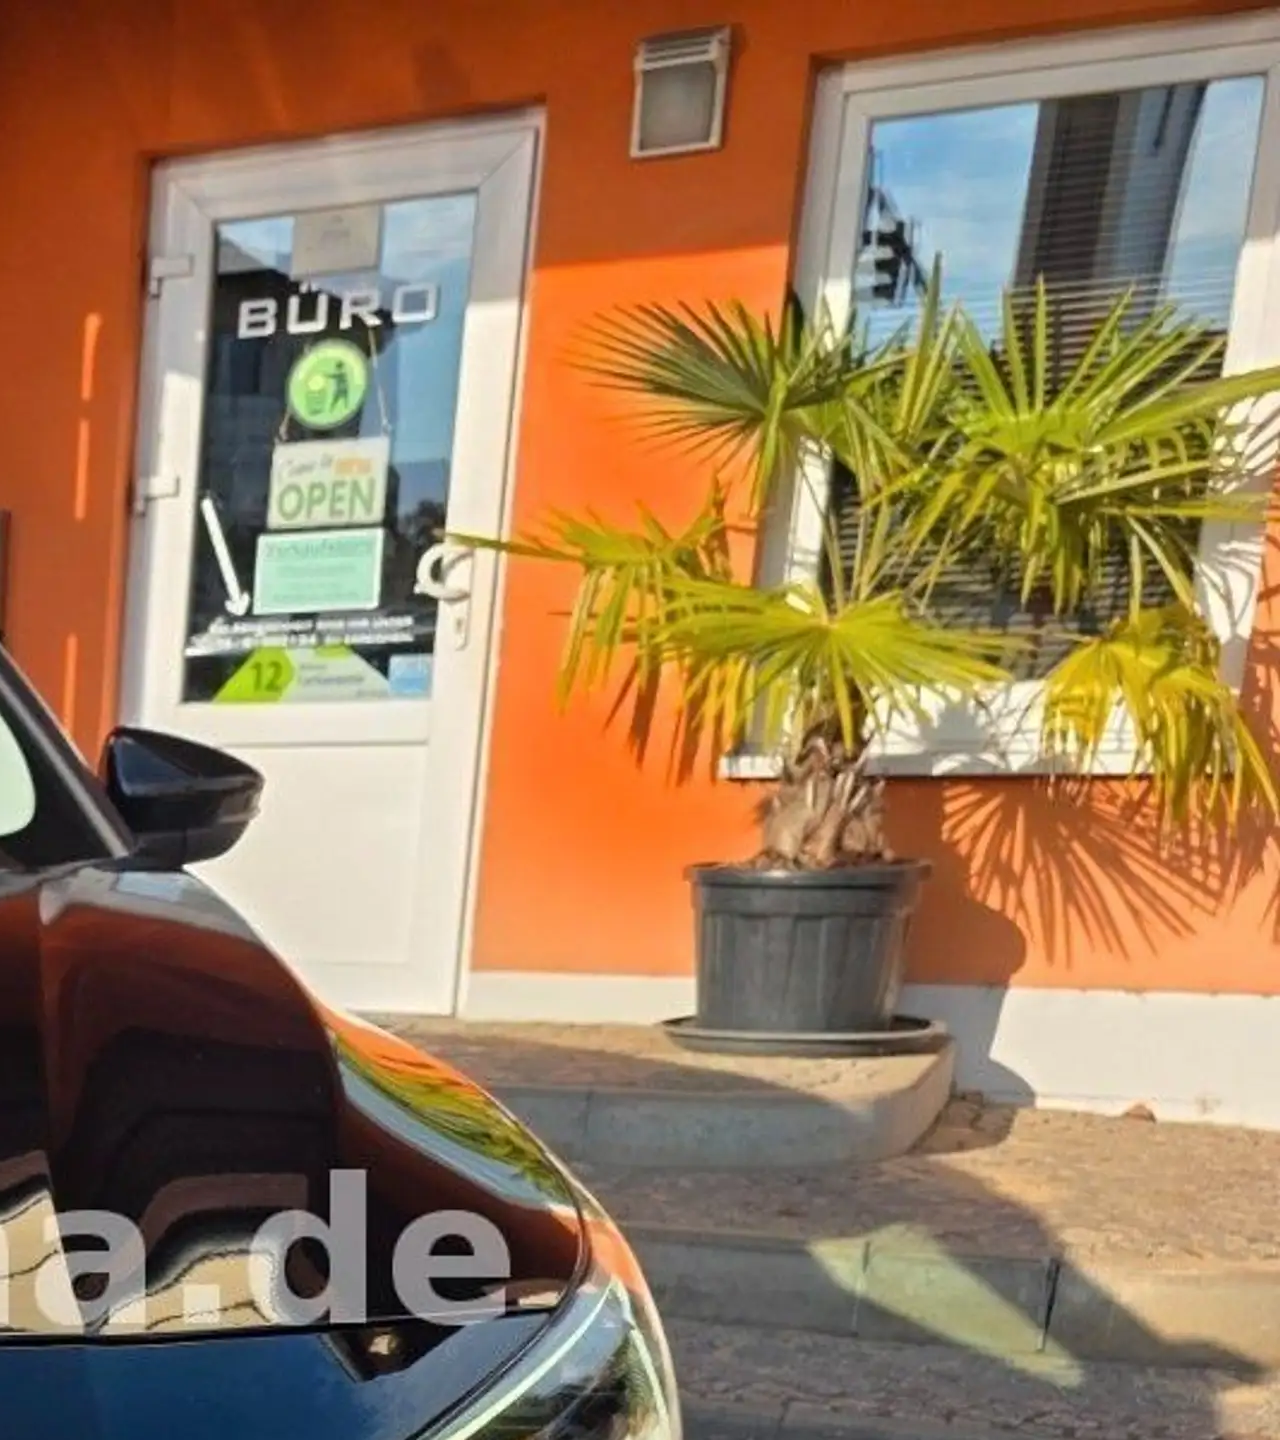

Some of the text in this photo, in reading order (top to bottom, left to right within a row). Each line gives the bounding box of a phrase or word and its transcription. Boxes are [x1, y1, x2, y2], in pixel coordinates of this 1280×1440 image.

[238, 281, 438, 339] BÜRO
[277, 477, 377, 522] OPEN
[250, 660, 284, 693] 12
